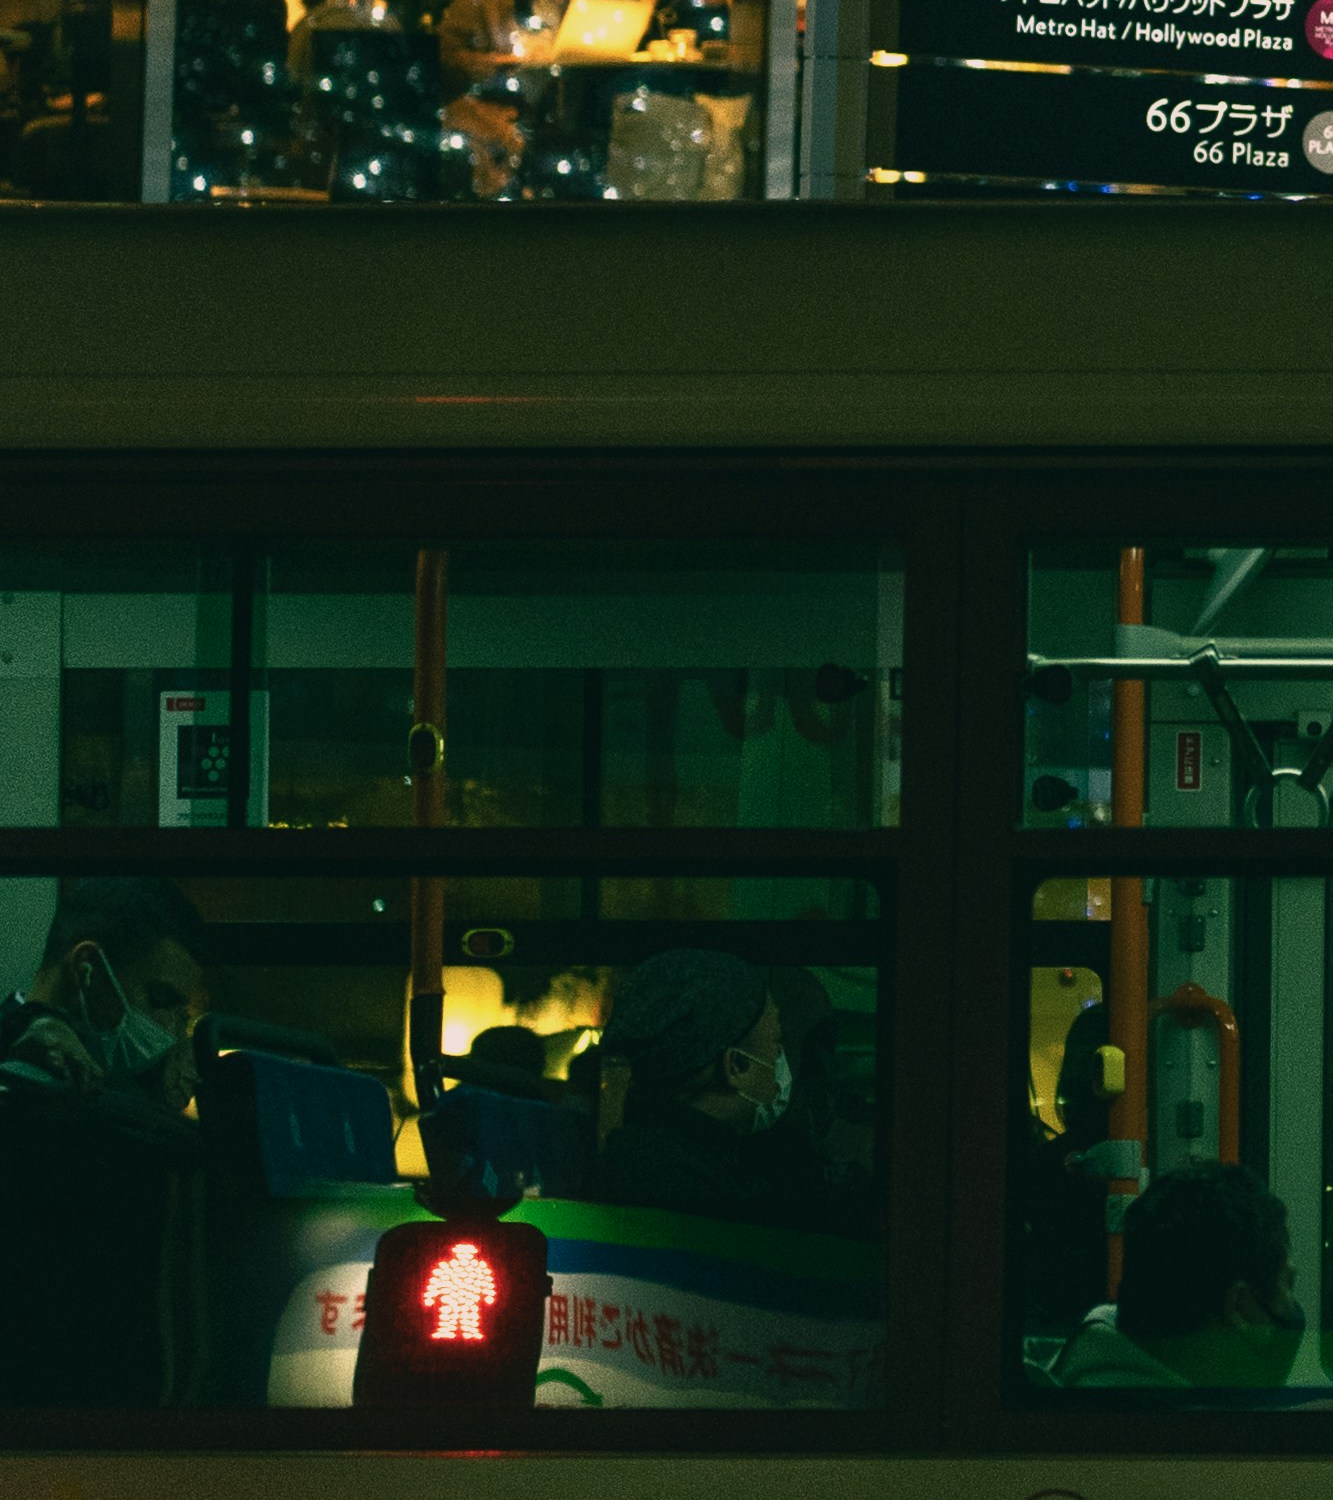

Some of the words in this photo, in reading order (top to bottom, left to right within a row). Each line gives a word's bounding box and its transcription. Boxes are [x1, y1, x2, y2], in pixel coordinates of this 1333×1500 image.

[1016, 14, 1078, 38] Metro
[1081, 18, 1117, 40] Hat
[1135, 22, 1241, 50] Hollywood
[1243, 28, 1294, 51] Plaza
[1146, 98, 1294, 138] 66プラザ
[1193, 140, 1225, 164] 66
[1232, 142, 1290, 168] Plaza
